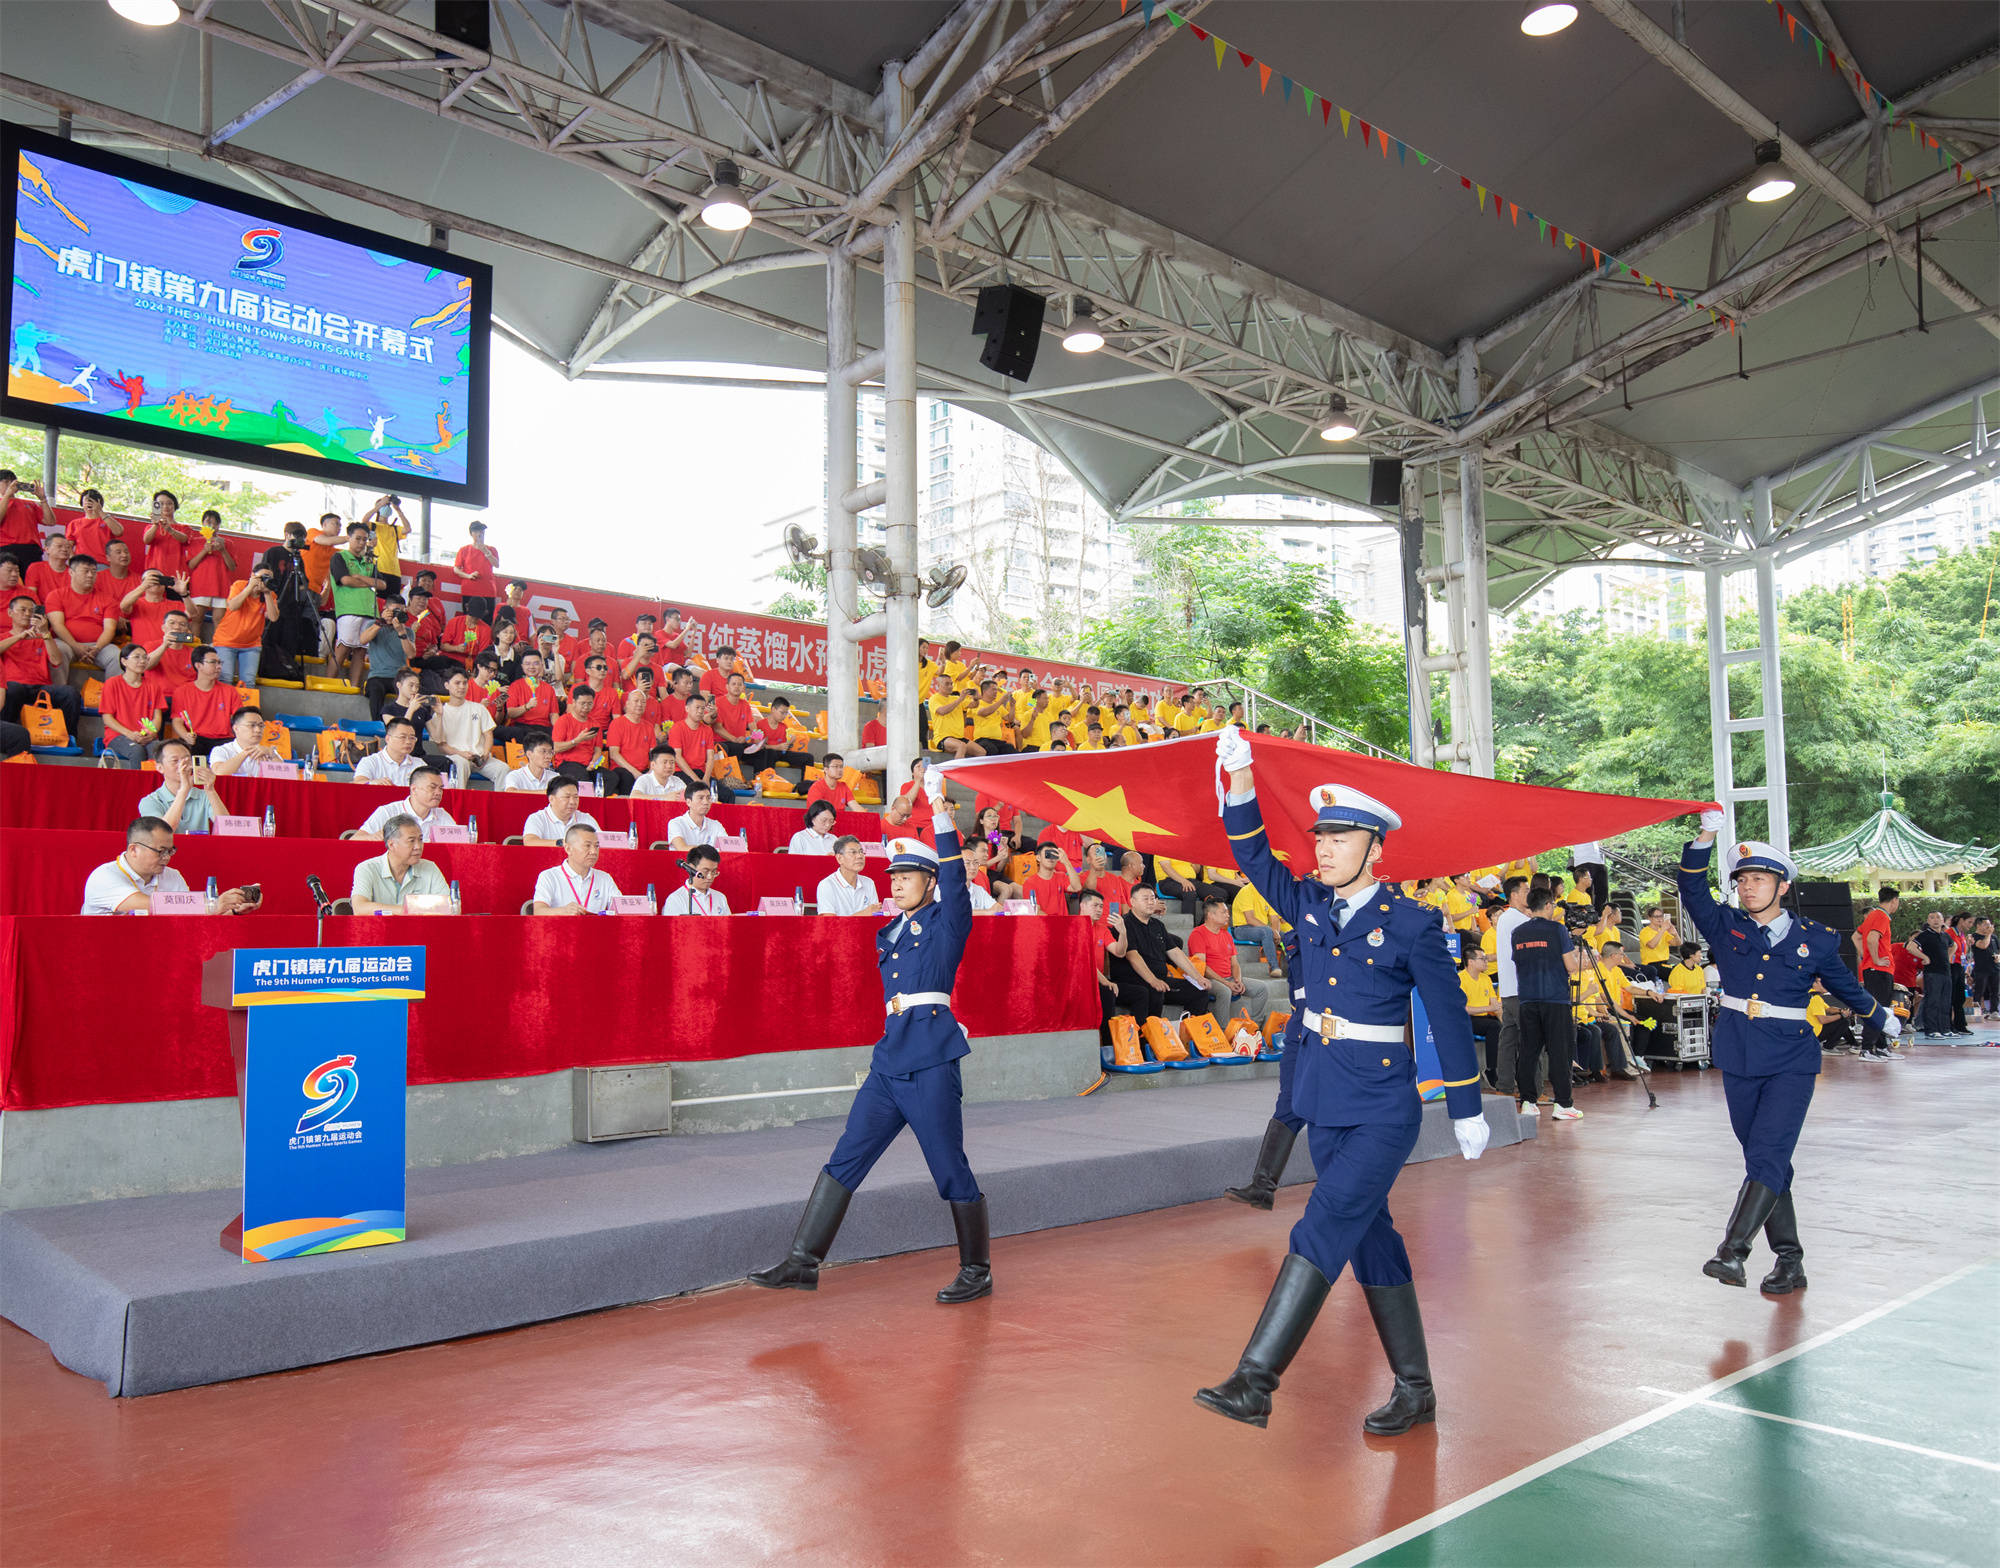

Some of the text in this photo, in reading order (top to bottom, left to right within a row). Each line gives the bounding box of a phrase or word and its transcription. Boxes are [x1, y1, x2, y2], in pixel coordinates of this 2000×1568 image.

[57, 246, 434, 364] 虎门镇第九届运动会开幕式
[135, 298, 165, 313] 2024
[166, 305, 191, 320] THE
[207, 316, 252, 335] HUMEN
[254, 327, 287, 342] TOWN
[288, 335, 334, 353] SPORTS
[335, 347, 373, 362] GAMES
[253, 956, 413, 977] 虎门镇第九届运动会
[255, 974, 410, 987] The 9th Humen Town Sports Games
[289, 1130, 362, 1146] 虎门镇第九届运动会
